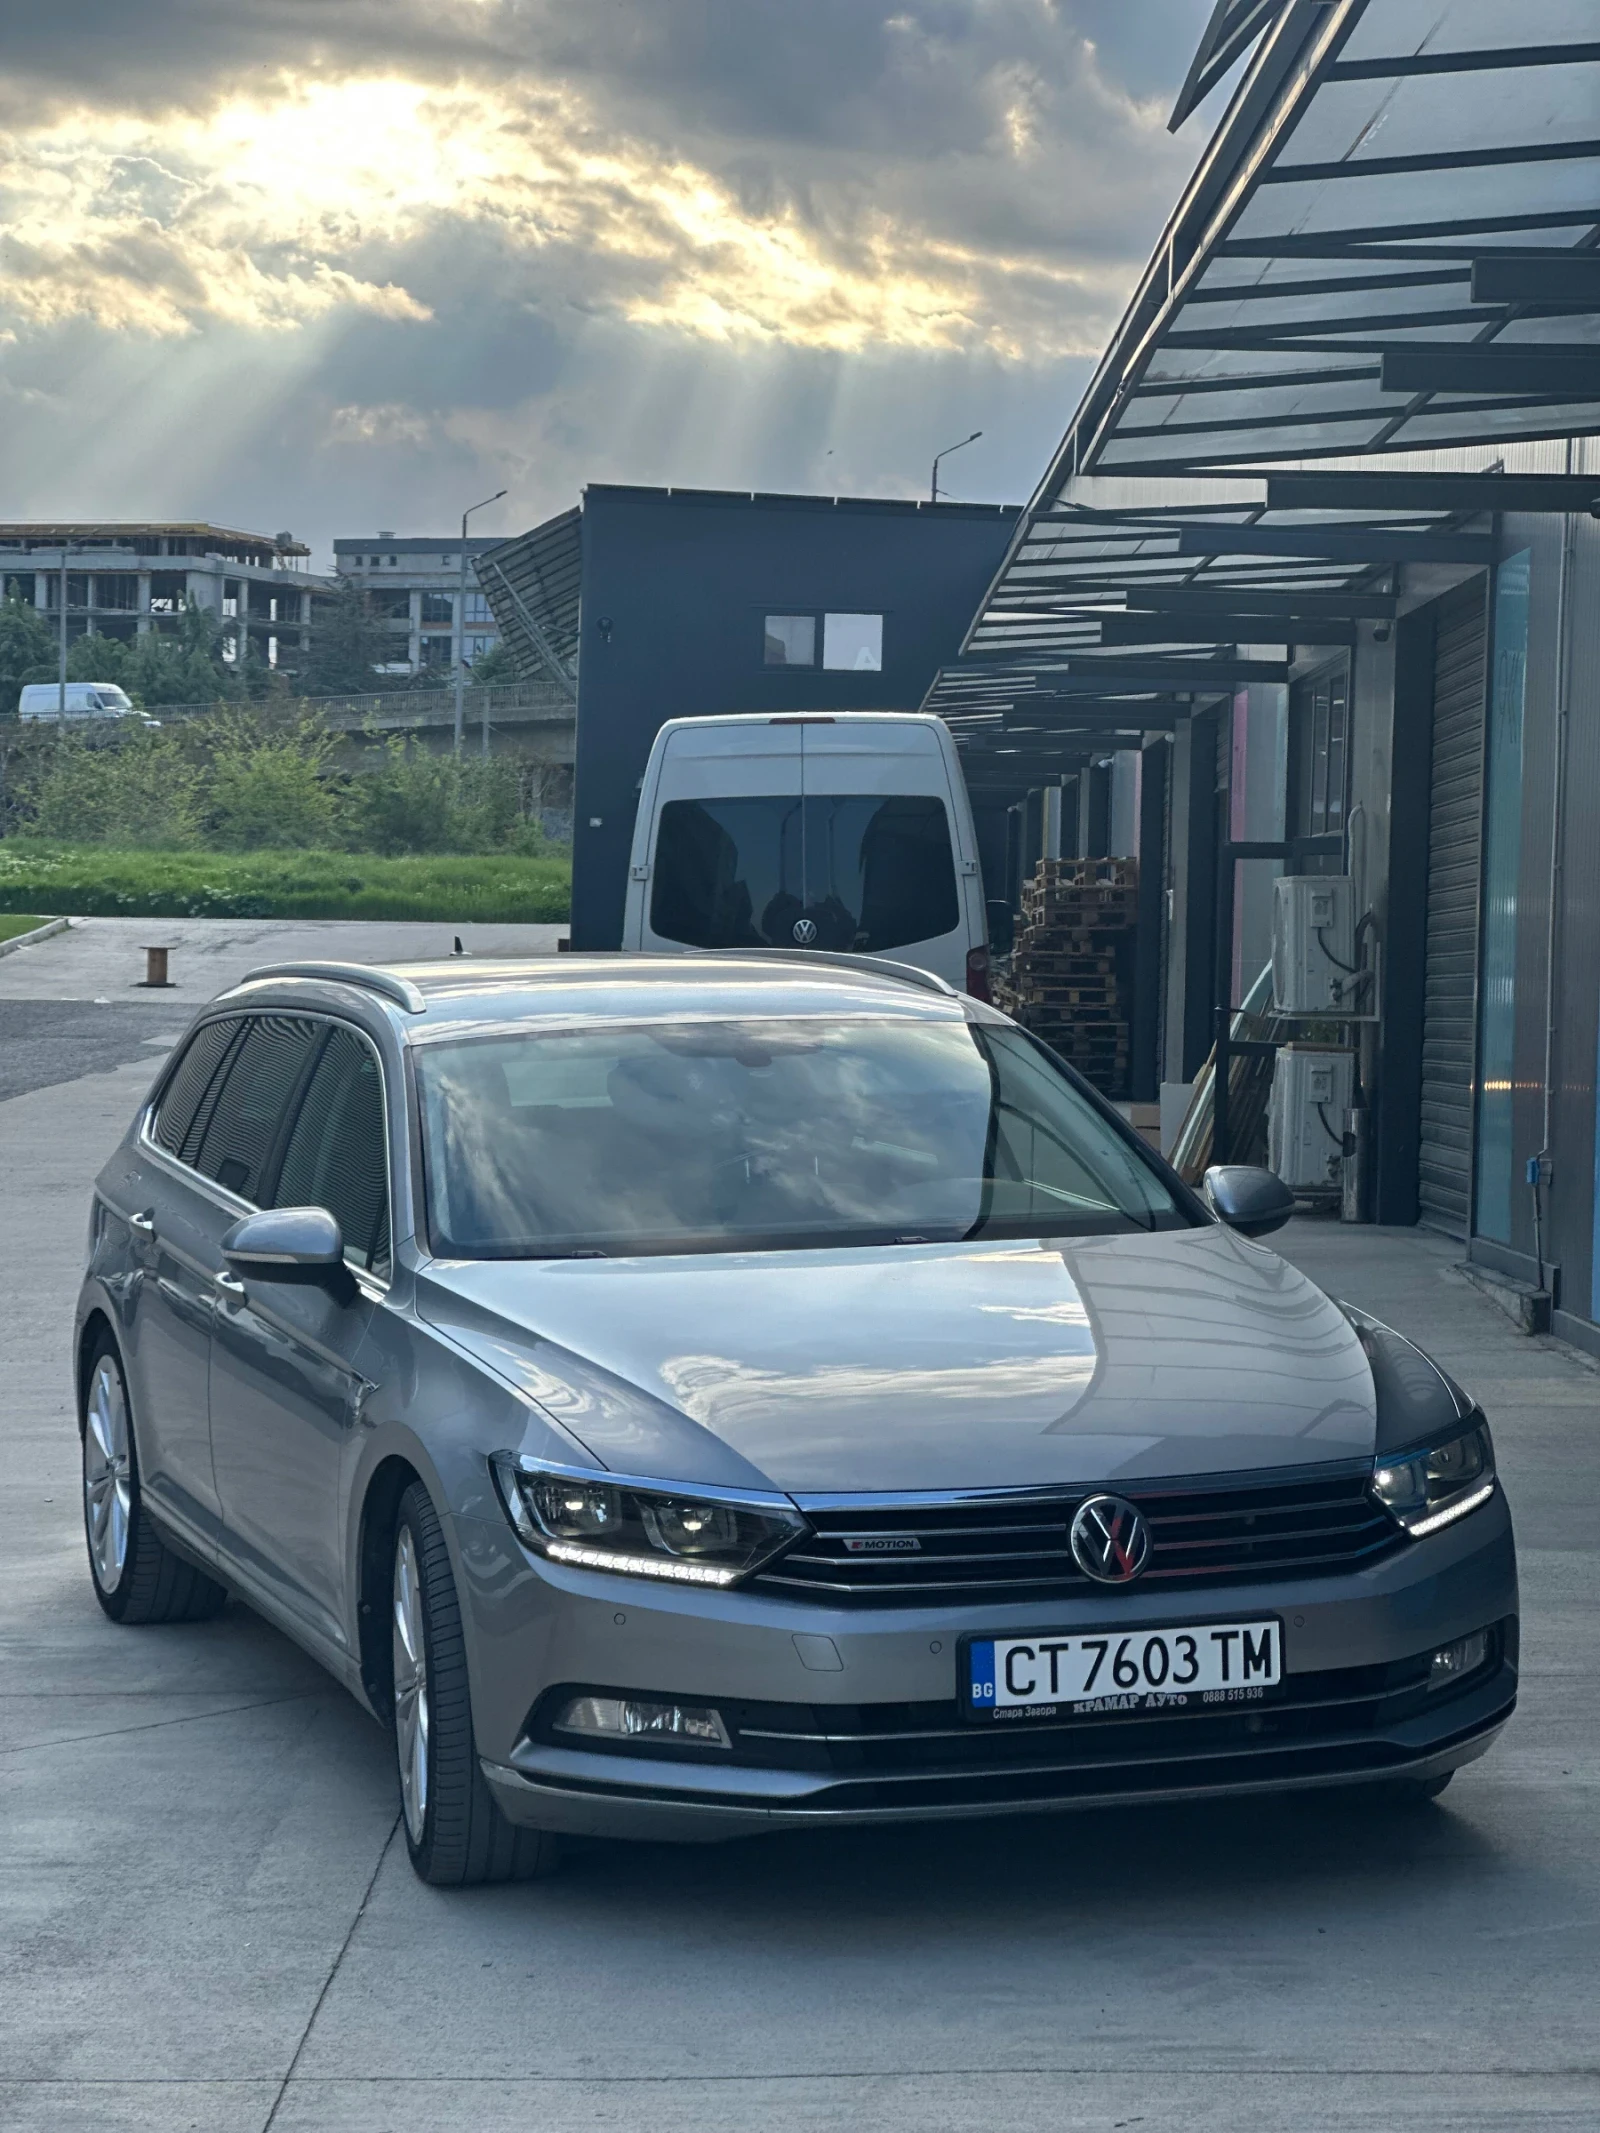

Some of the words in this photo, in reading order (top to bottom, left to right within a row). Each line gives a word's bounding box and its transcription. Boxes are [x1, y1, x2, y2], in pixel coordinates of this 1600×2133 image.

[1005, 1643, 1069, 1696] CT
[1081, 1636, 1200, 1691] 7603
[1211, 1628, 1272, 1682] TM
[972, 1682, 994, 1698] BG
[1203, 1691, 1226, 1703] 0888
[1228, 1689, 1245, 1701] 515
